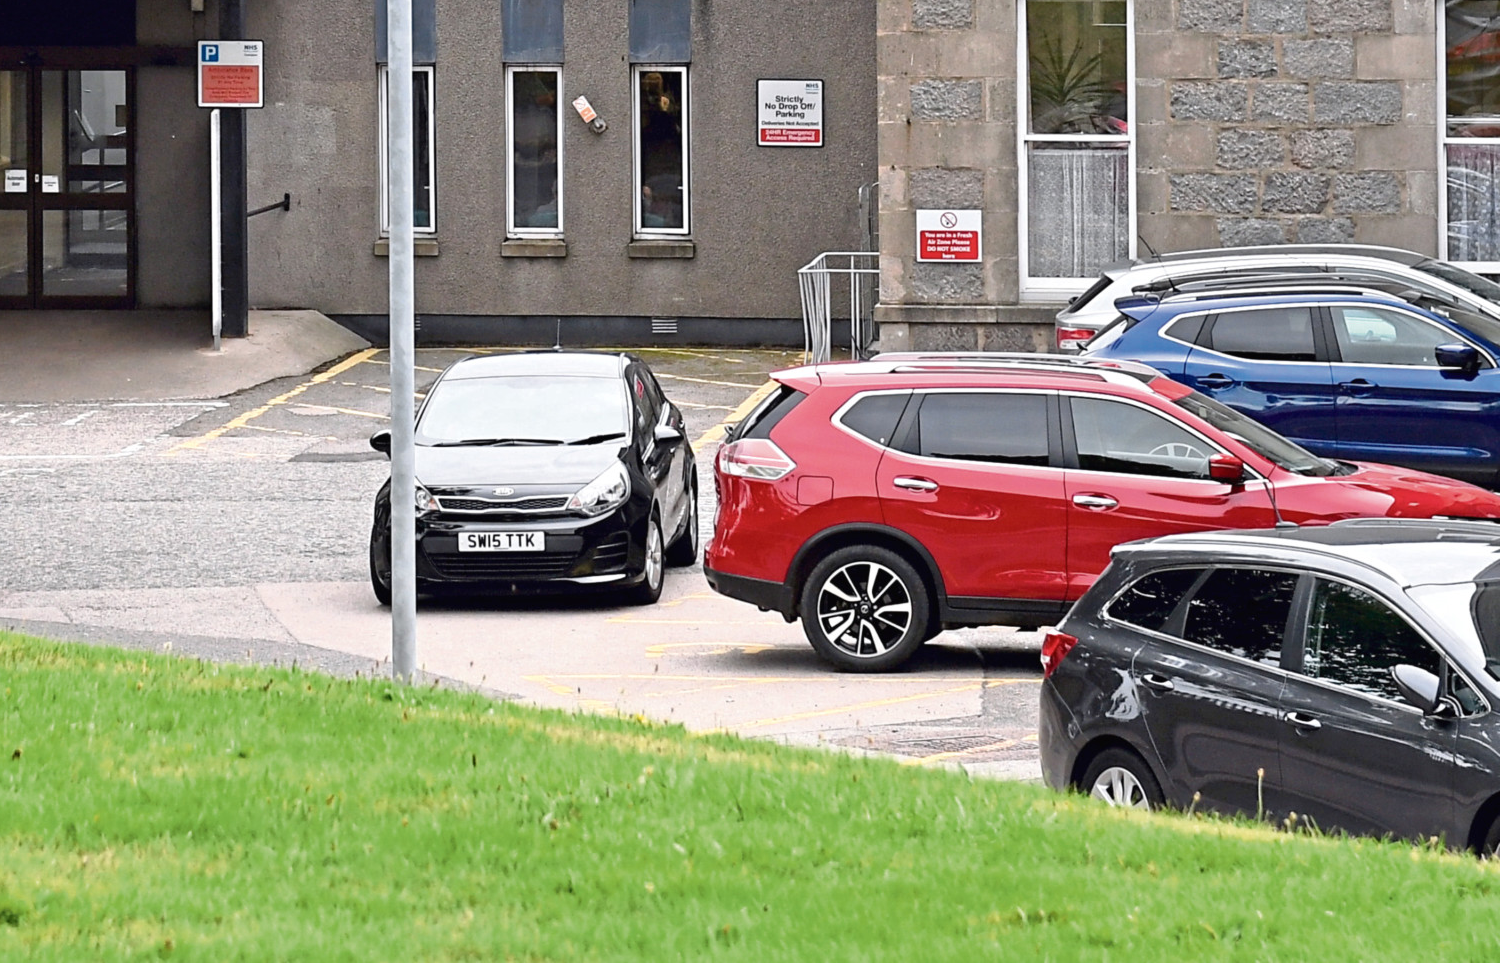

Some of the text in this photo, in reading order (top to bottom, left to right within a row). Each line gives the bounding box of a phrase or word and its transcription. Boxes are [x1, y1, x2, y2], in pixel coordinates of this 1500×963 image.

[205, 46, 217, 61] P
[775, 95, 804, 104] Strictly
[778, 103, 798, 112] Drop
[775, 110, 805, 119] Parking
[467, 533, 536, 548] SW15 TTK
